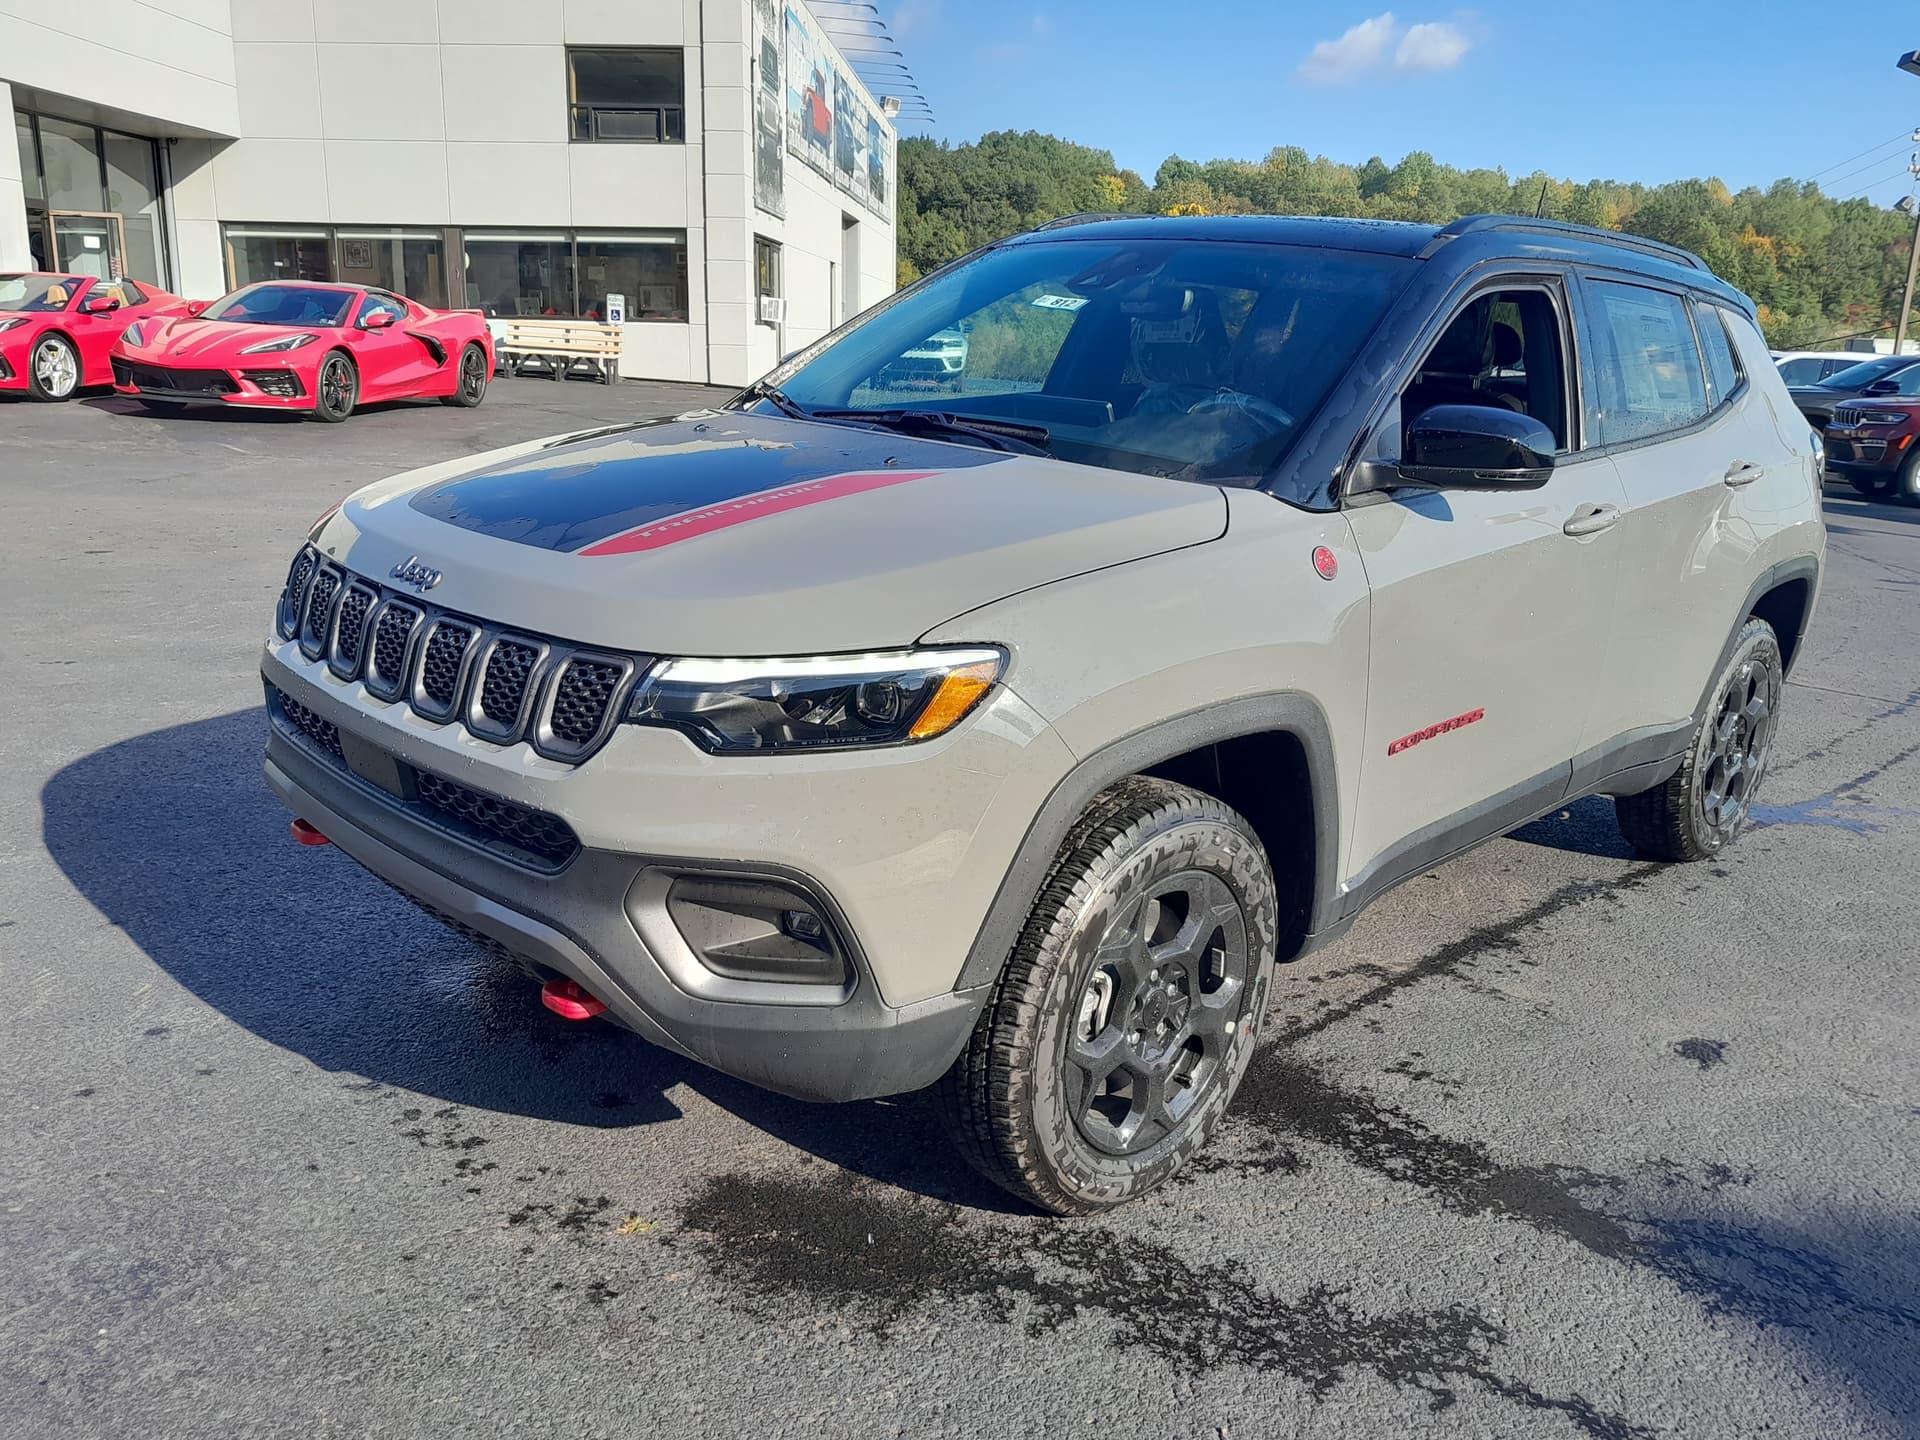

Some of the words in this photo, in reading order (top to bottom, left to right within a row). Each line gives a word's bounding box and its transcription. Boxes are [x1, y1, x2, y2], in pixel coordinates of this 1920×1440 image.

[630, 483, 826, 539] TRAILHAWK
[389, 554, 443, 593] Jeep
[1387, 706, 1485, 757] COMPASS
